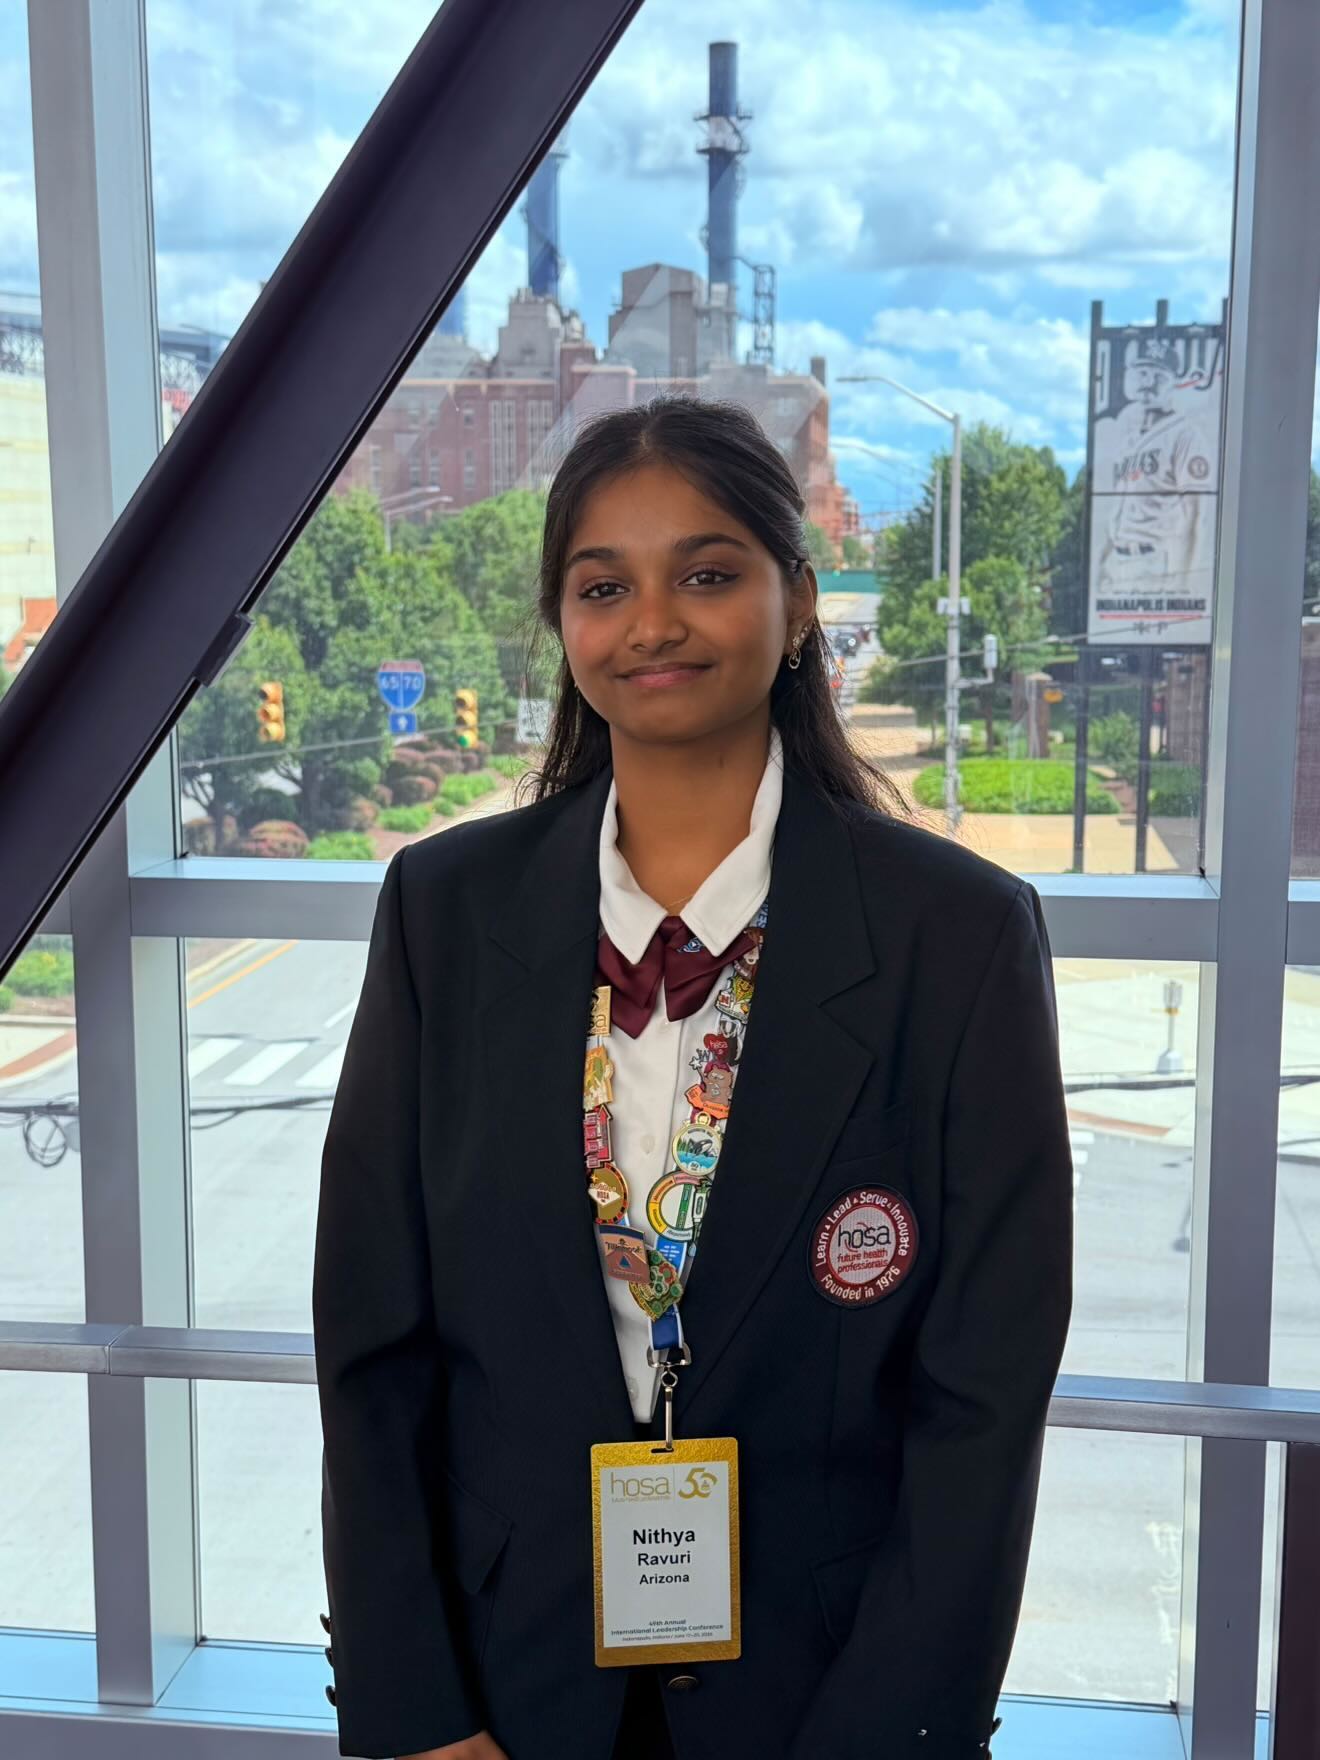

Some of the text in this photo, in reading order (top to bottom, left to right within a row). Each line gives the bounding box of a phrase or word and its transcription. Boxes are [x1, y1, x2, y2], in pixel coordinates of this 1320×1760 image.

[1096, 598, 1206, 612] INDIANAPOLIS INDIANS
[381, 676, 421, 689] 65 70
[815, 1191, 910, 1267] Learn Lead Serve Innovate
[837, 1224, 892, 1249] hosa
[837, 1247, 888, 1263] future health
[837, 1258, 889, 1274] professionals
[821, 1265, 901, 1300] Founded in 1976
[610, 1472, 671, 1497] hosa
[632, 1528, 696, 1547] Nithya
[637, 1551, 691, 1566] Ravuri
[639, 1573, 690, 1585] Arizona
[611, 1628, 652, 1636] International
[652, 1626, 688, 1634] Leadership
